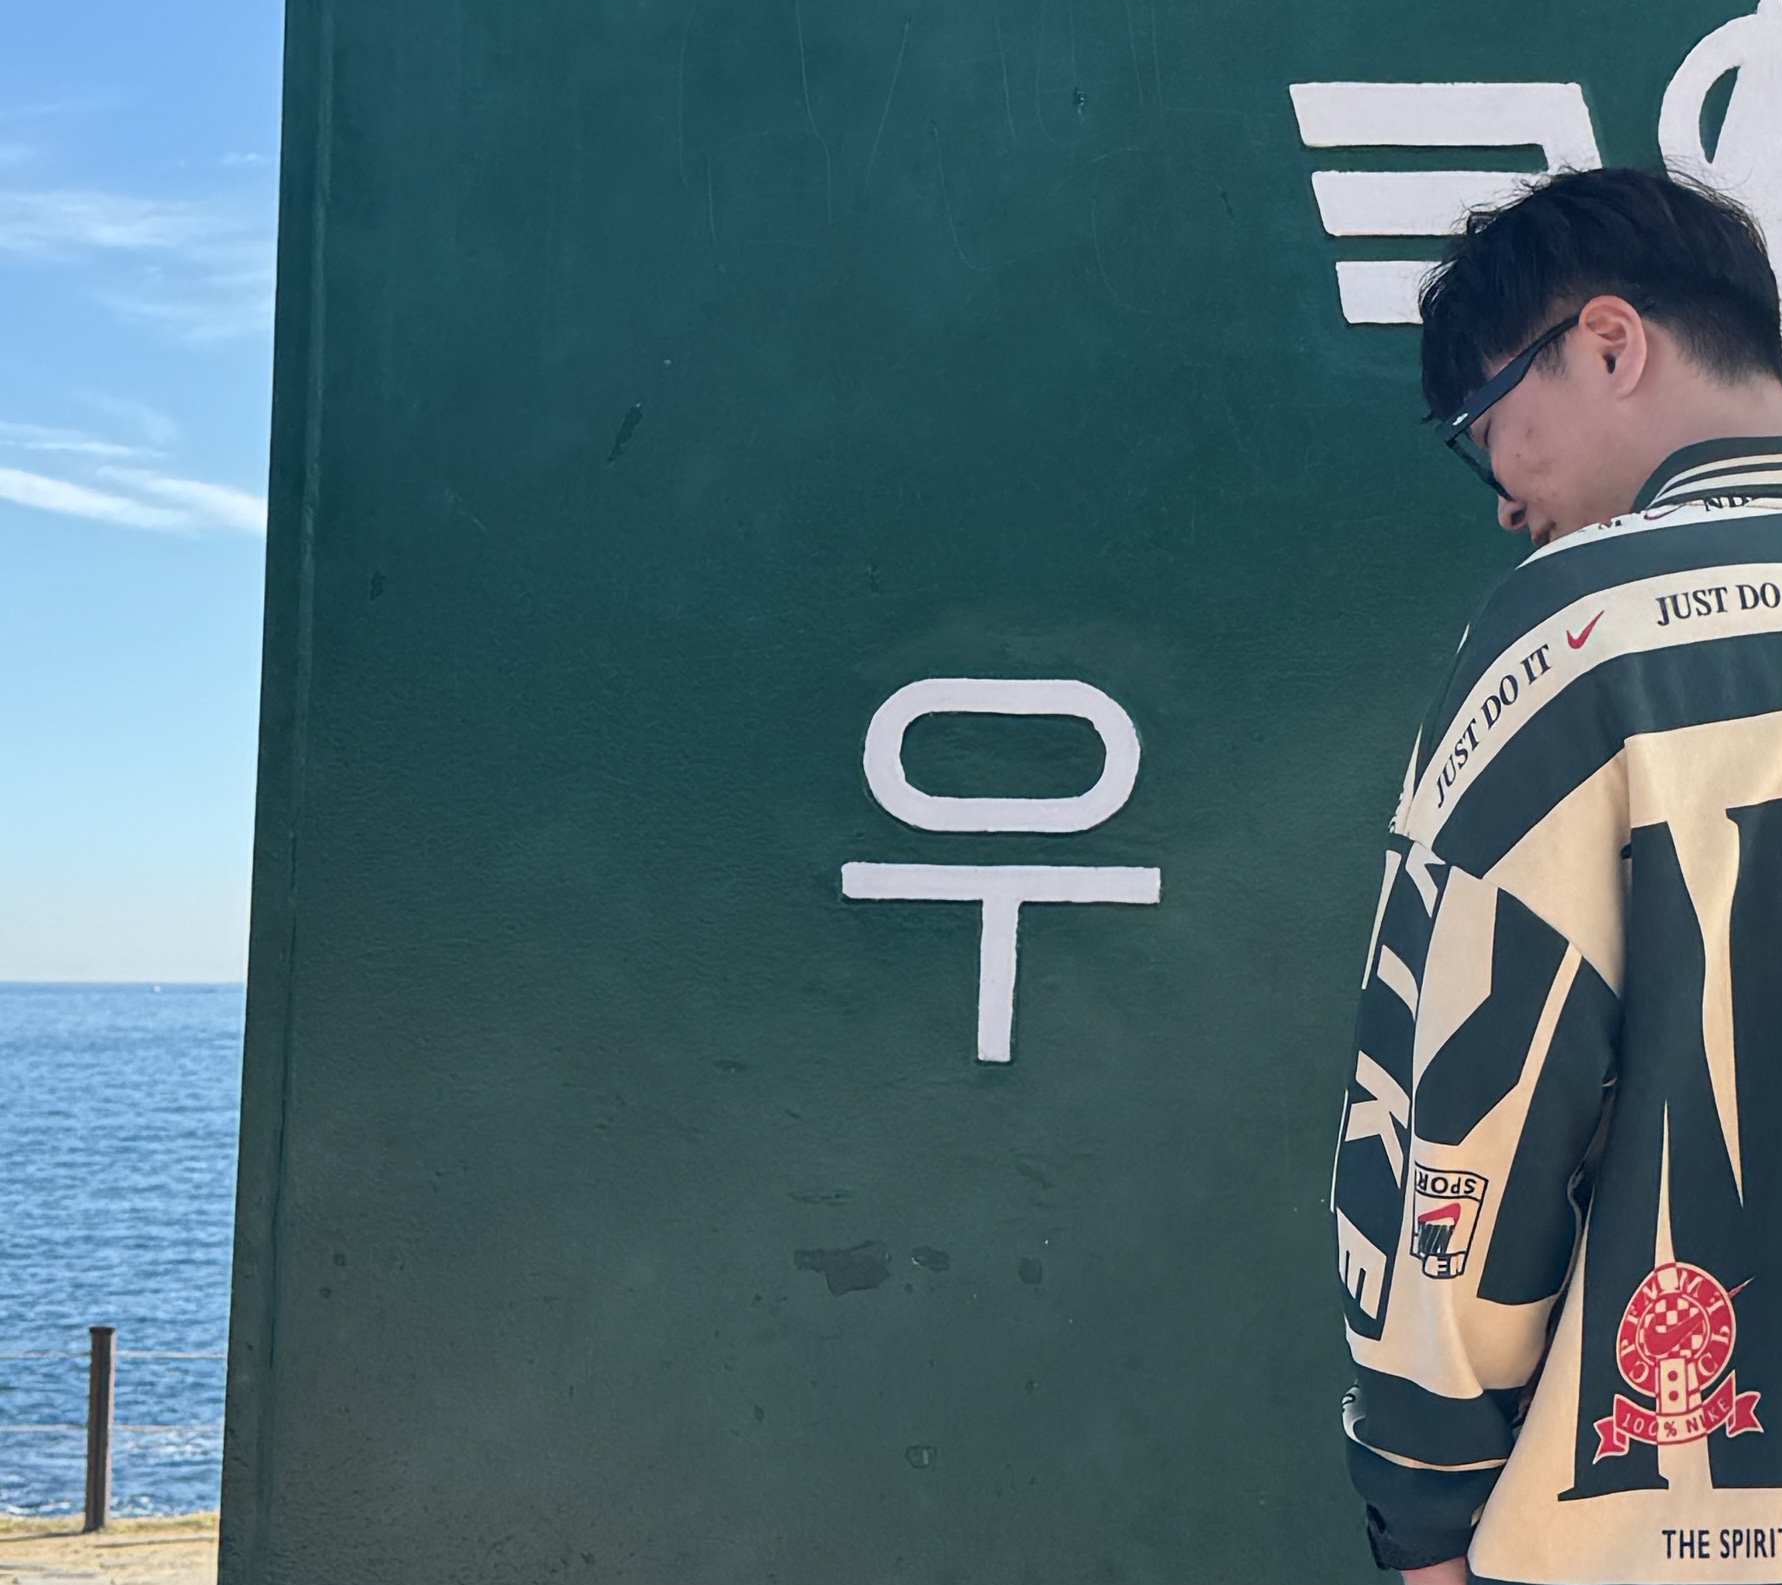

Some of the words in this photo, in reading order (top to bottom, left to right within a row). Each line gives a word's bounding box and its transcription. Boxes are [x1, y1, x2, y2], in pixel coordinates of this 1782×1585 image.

[1655, 587, 1728, 626] JUST
[1735, 582, 1781, 610] DO
[1435, 717, 1480, 809] JUST
[1480, 674, 1520, 731] DO
[1519, 643, 1553, 686] IT
[841, 677, 1161, 1062] 우
[1620, 1412, 1678, 1438] 100%
[1685, 1398, 1731, 1433] NIKE
[1661, 1529, 1711, 1560] THE
